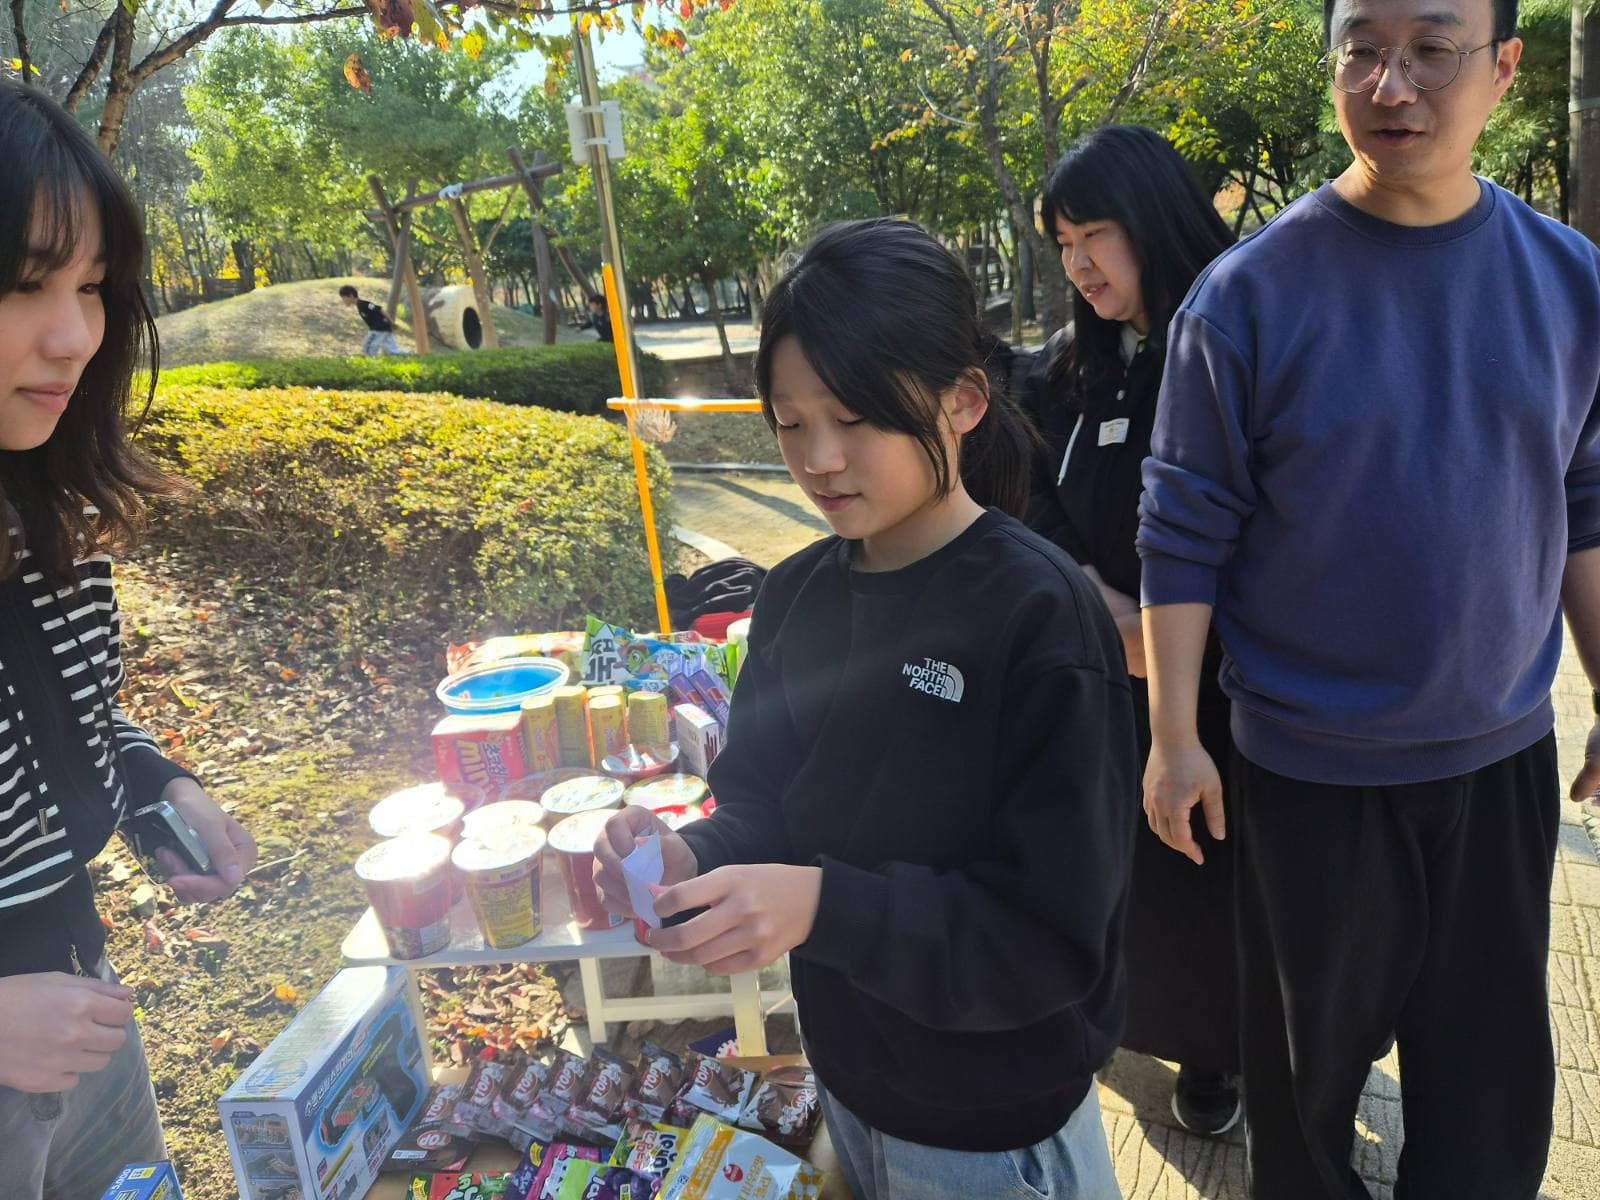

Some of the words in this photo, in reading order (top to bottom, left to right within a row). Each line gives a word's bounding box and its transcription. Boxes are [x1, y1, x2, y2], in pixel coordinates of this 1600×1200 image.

[902, 663, 946, 685] NORTH
[924, 657, 947, 675] THE
[909, 677, 941, 696] FACE
[474, 1073, 490, 1098] TOP
[518, 1070, 536, 1094] TOP
[555, 1068, 572, 1090] TOP
[592, 1074, 608, 1096] TOP
[644, 1067, 659, 1089] TOP
[695, 1063, 708, 1086] TOP
[426, 1095, 446, 1120] TOP
[421, 1133, 448, 1146] TOP
